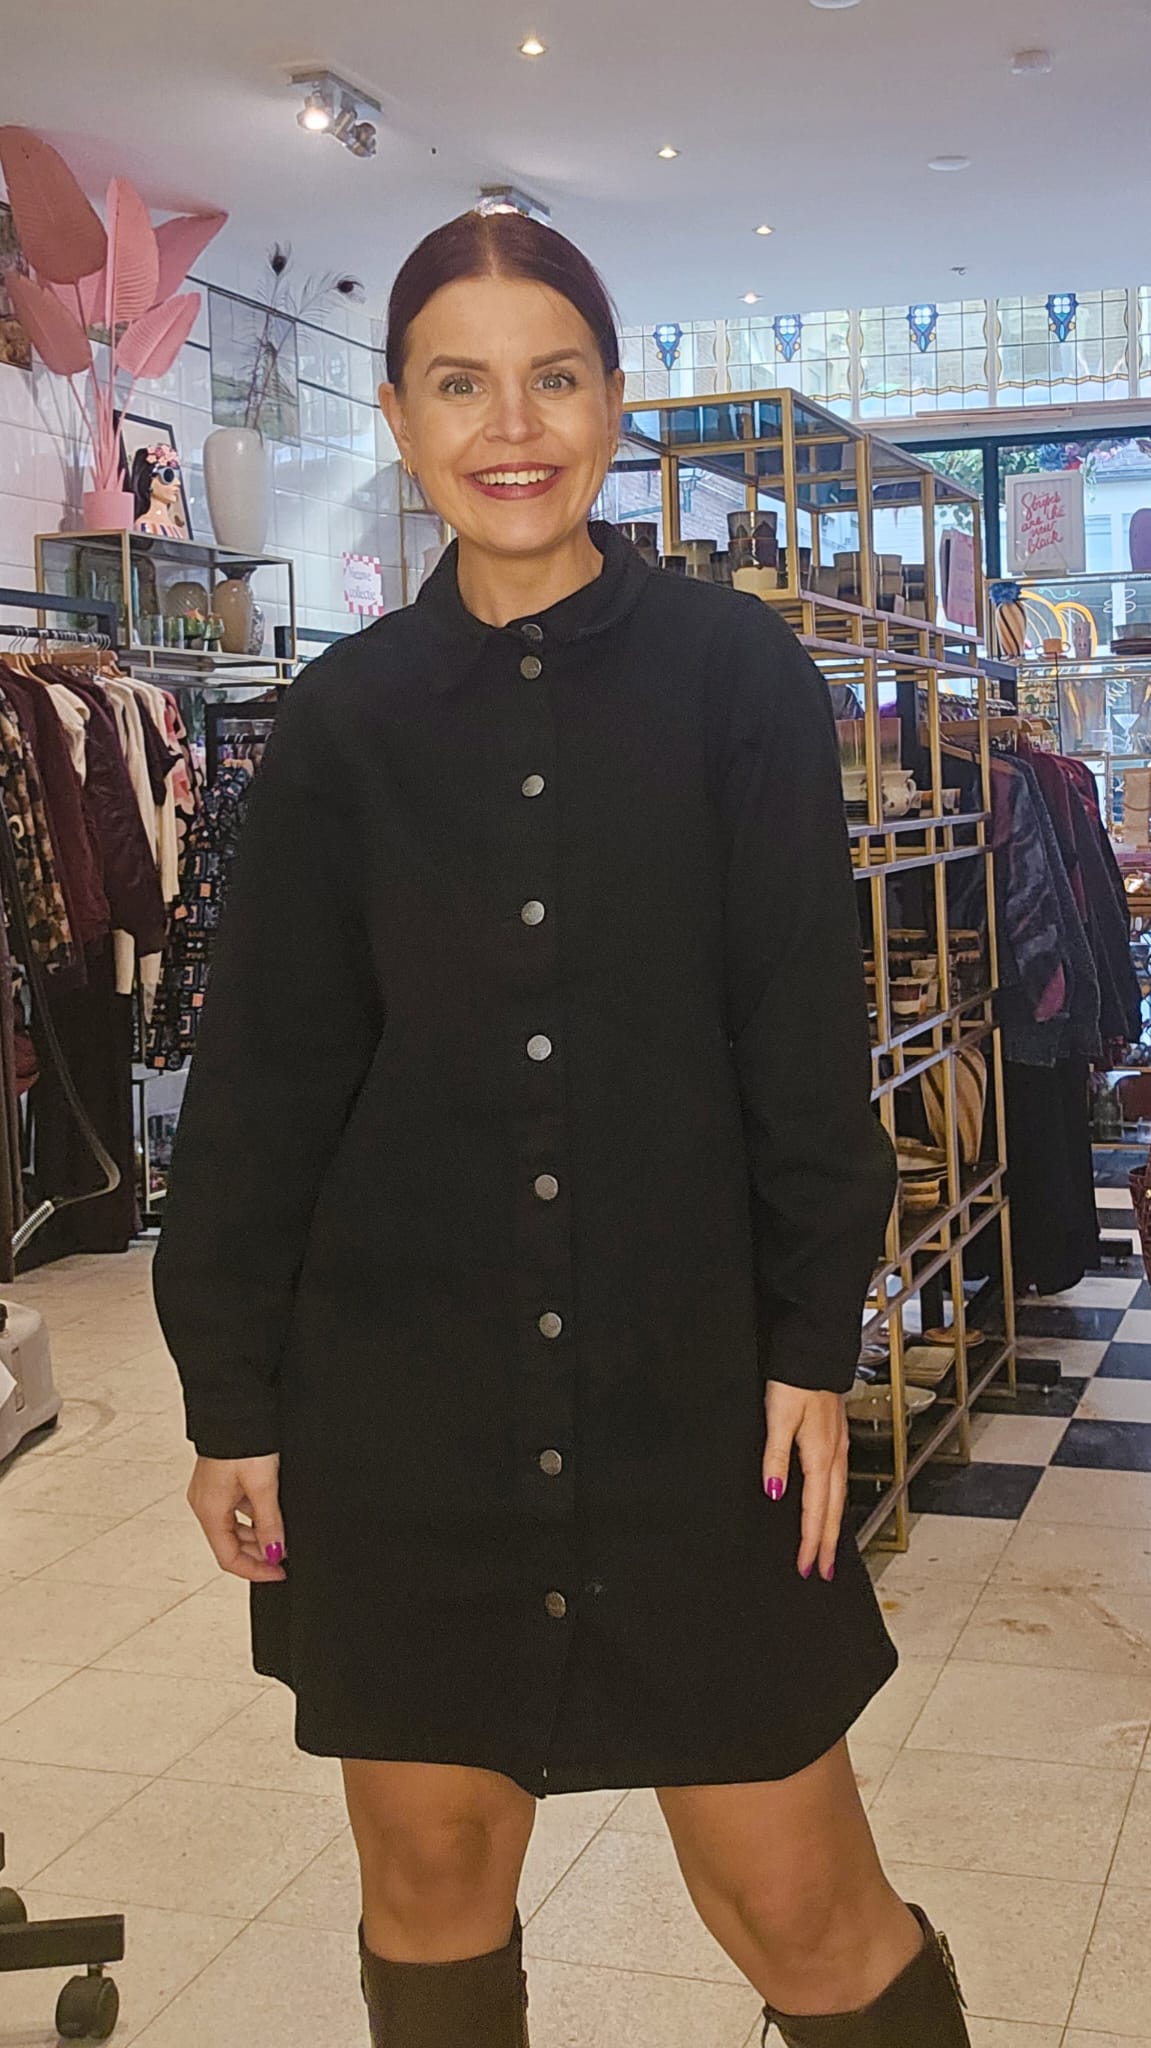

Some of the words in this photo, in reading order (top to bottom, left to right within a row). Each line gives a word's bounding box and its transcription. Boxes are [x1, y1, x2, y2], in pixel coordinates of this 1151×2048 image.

[1021, 516, 1042, 532] are
[1046, 504, 1066, 520] the
[1031, 520, 1056, 538] new
[1028, 530, 1064, 554] black
